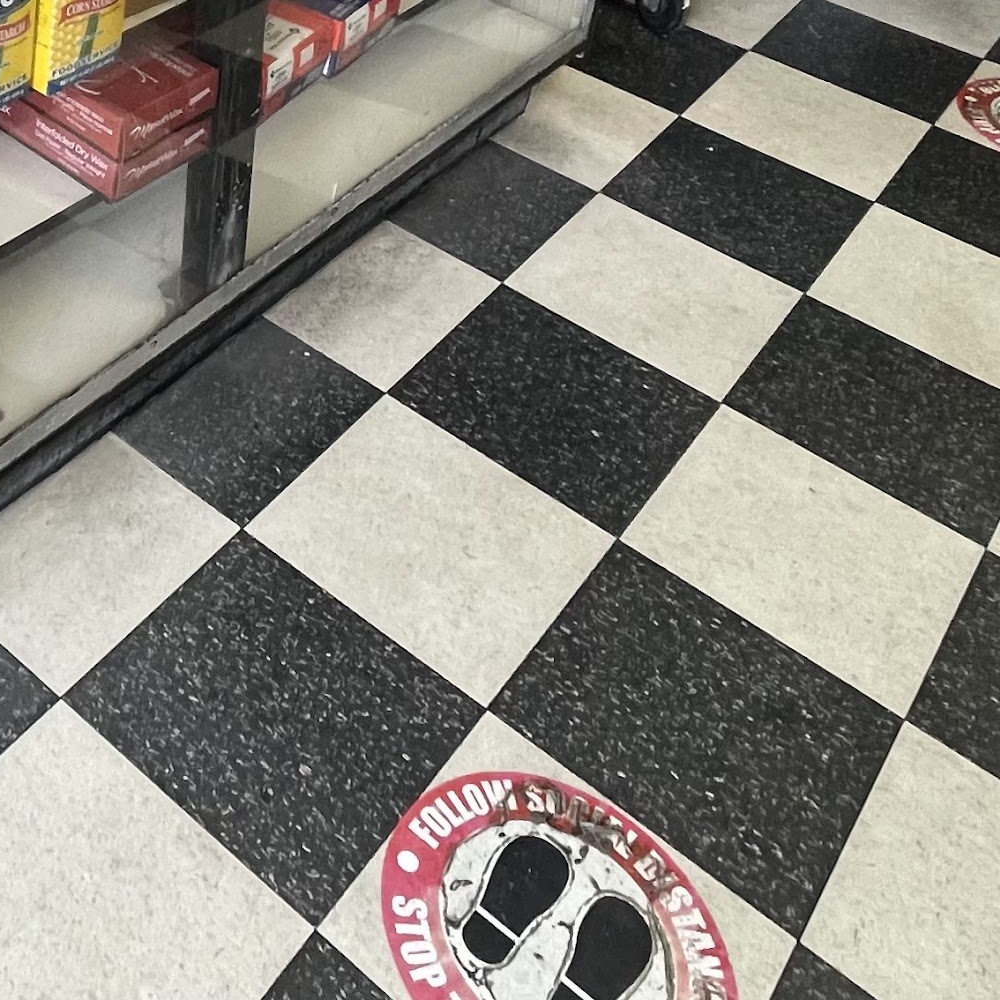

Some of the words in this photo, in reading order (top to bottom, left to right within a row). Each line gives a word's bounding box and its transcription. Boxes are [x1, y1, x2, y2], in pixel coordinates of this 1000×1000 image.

[66, 0, 91, 17] CORN
[74, 142, 91, 161] Dry
[408, 778, 519, 849] FOLLOW
[391, 894, 447, 988] STOP
